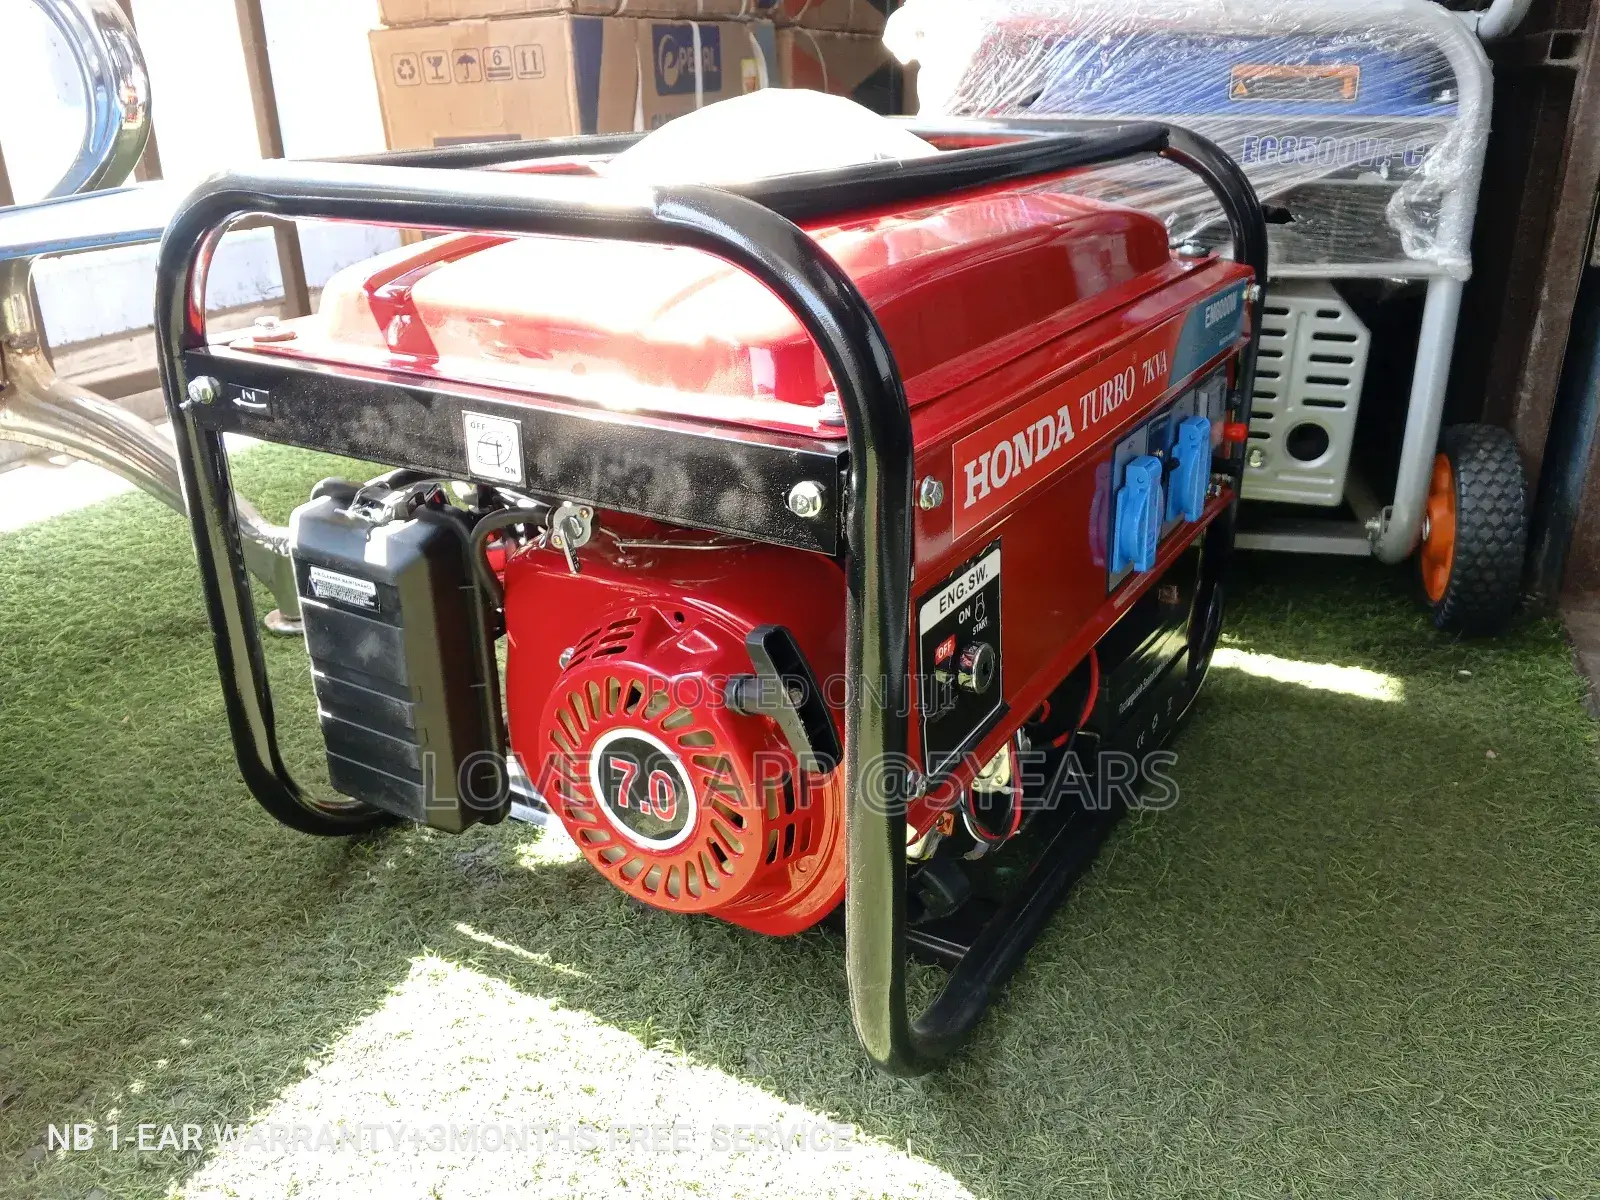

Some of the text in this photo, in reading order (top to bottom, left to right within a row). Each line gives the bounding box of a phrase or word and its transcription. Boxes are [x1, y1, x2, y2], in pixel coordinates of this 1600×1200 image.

[679, 45, 718, 74] PERL
[470, 421, 486, 431] OFF
[963, 349, 1168, 510] HONDA TURBO 7KVA
[504, 466, 517, 475] ON
[939, 563, 989, 615] ENG.SW.
[958, 604, 971, 625] ON
[972, 615, 989, 636] START
[937, 639, 952, 660] OFF
[608, 756, 679, 823] 7.0
